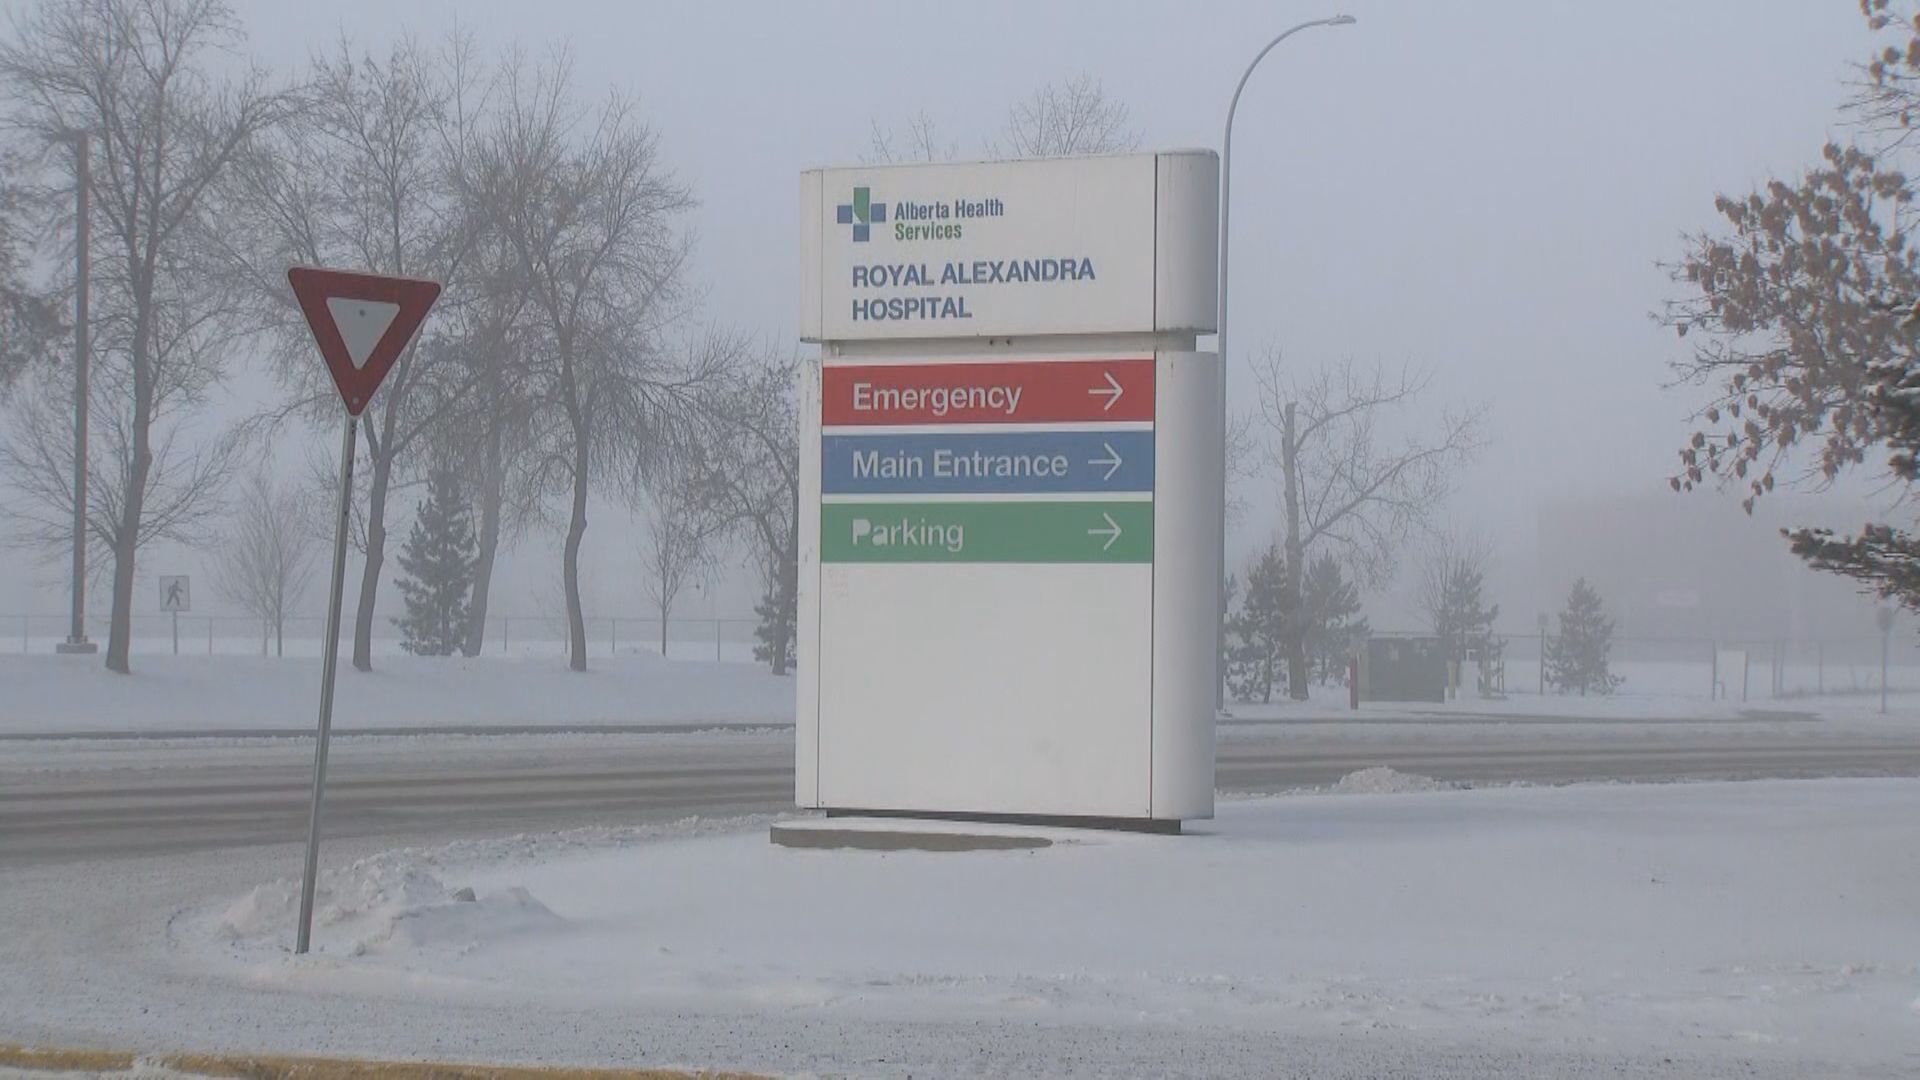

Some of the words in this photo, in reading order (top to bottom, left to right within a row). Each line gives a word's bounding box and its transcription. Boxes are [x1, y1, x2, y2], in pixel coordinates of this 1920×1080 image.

[894, 201, 950, 221] Alberta
[955, 198, 1004, 219] Health
[894, 221, 962, 241] Services
[852, 264, 935, 288] ROYAL
[941, 257, 1096, 285] ALEXANDRA
[852, 297, 972, 321] HOSPITAL
[852, 382, 1023, 416] Emergency
[852, 450, 923, 479] Main
[933, 449, 1069, 477] Entrance
[852, 518, 964, 552] Parking
